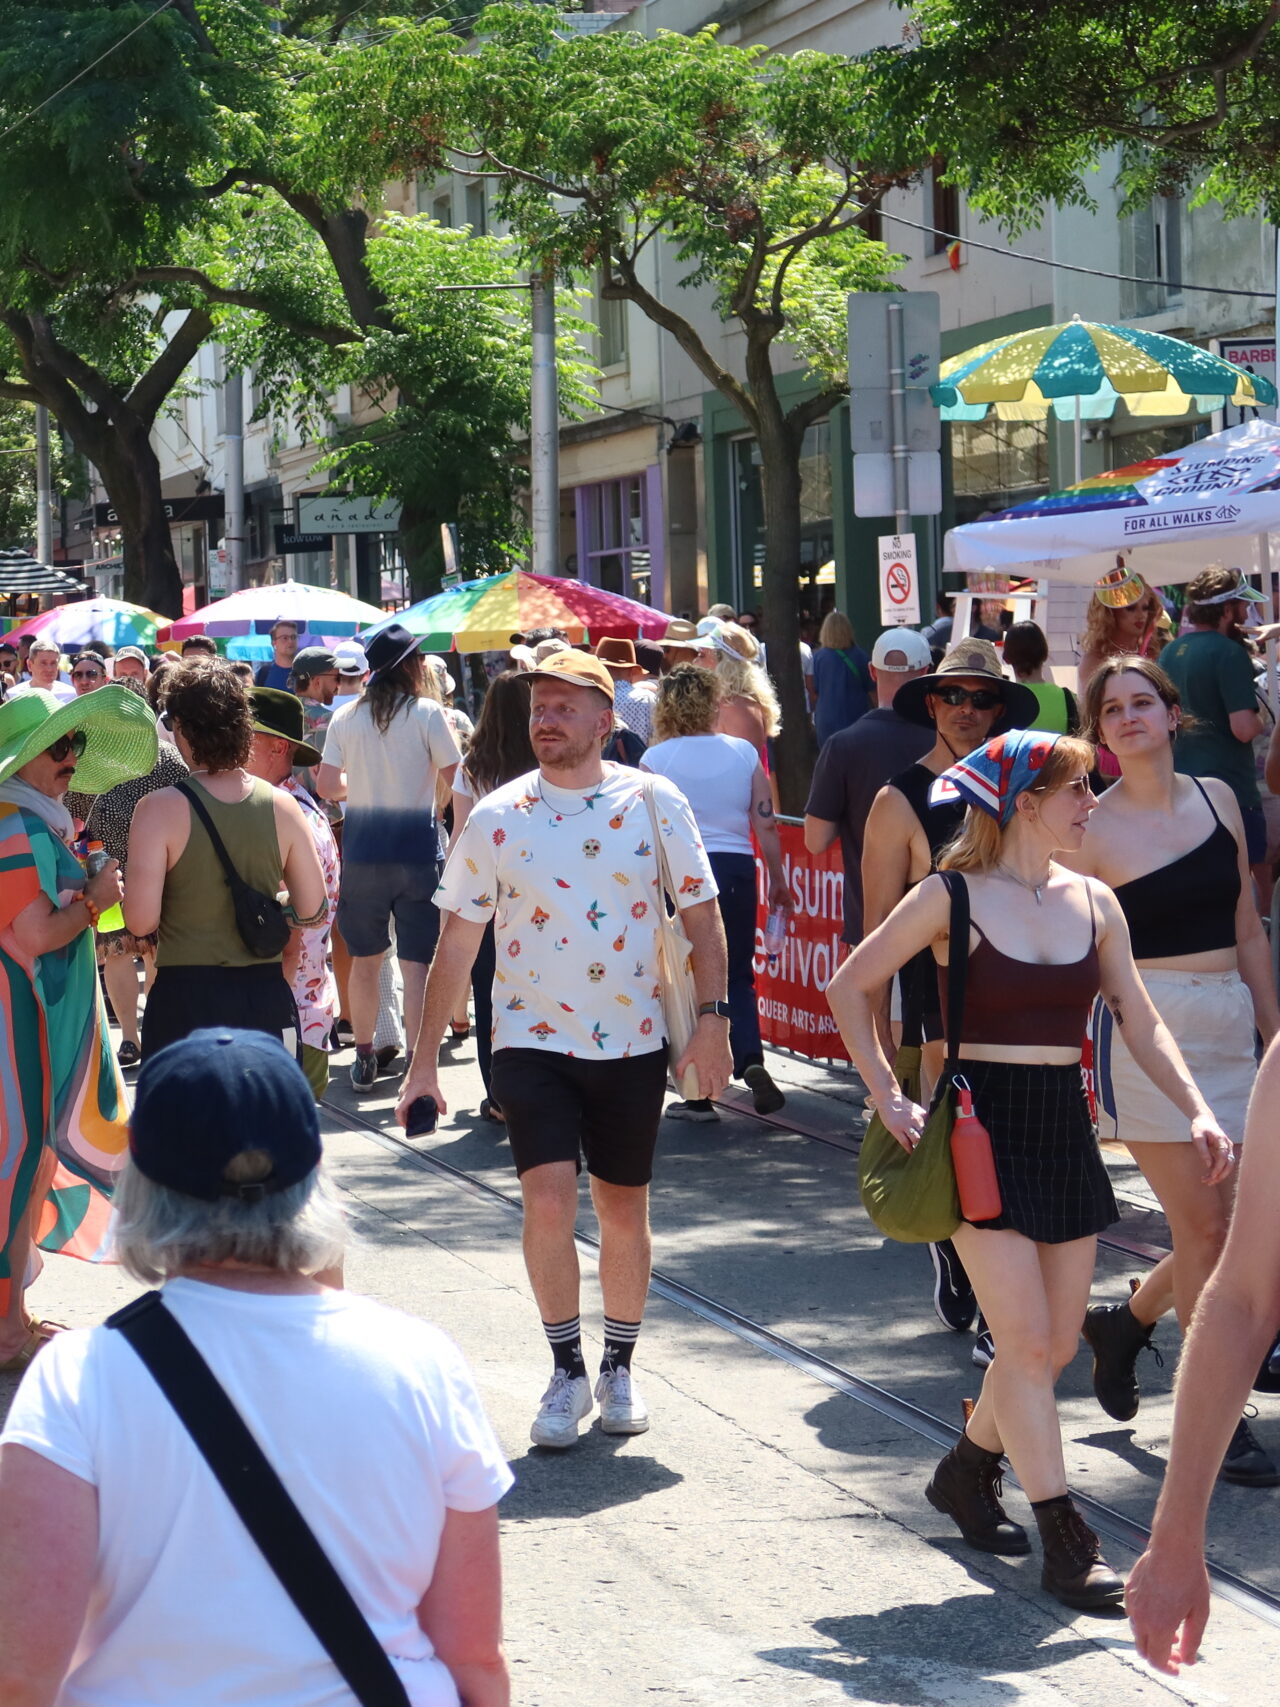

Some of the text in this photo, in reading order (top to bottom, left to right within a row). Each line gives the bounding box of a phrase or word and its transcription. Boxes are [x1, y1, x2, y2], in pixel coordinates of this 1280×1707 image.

[1124, 510, 1212, 532] FOR ALL WALKS
[892, 540, 901, 549] NO
[883, 550, 912, 560] SMOKING
[757, 996, 788, 1023] QUEER
[791, 1007, 816, 1034] ARTS
